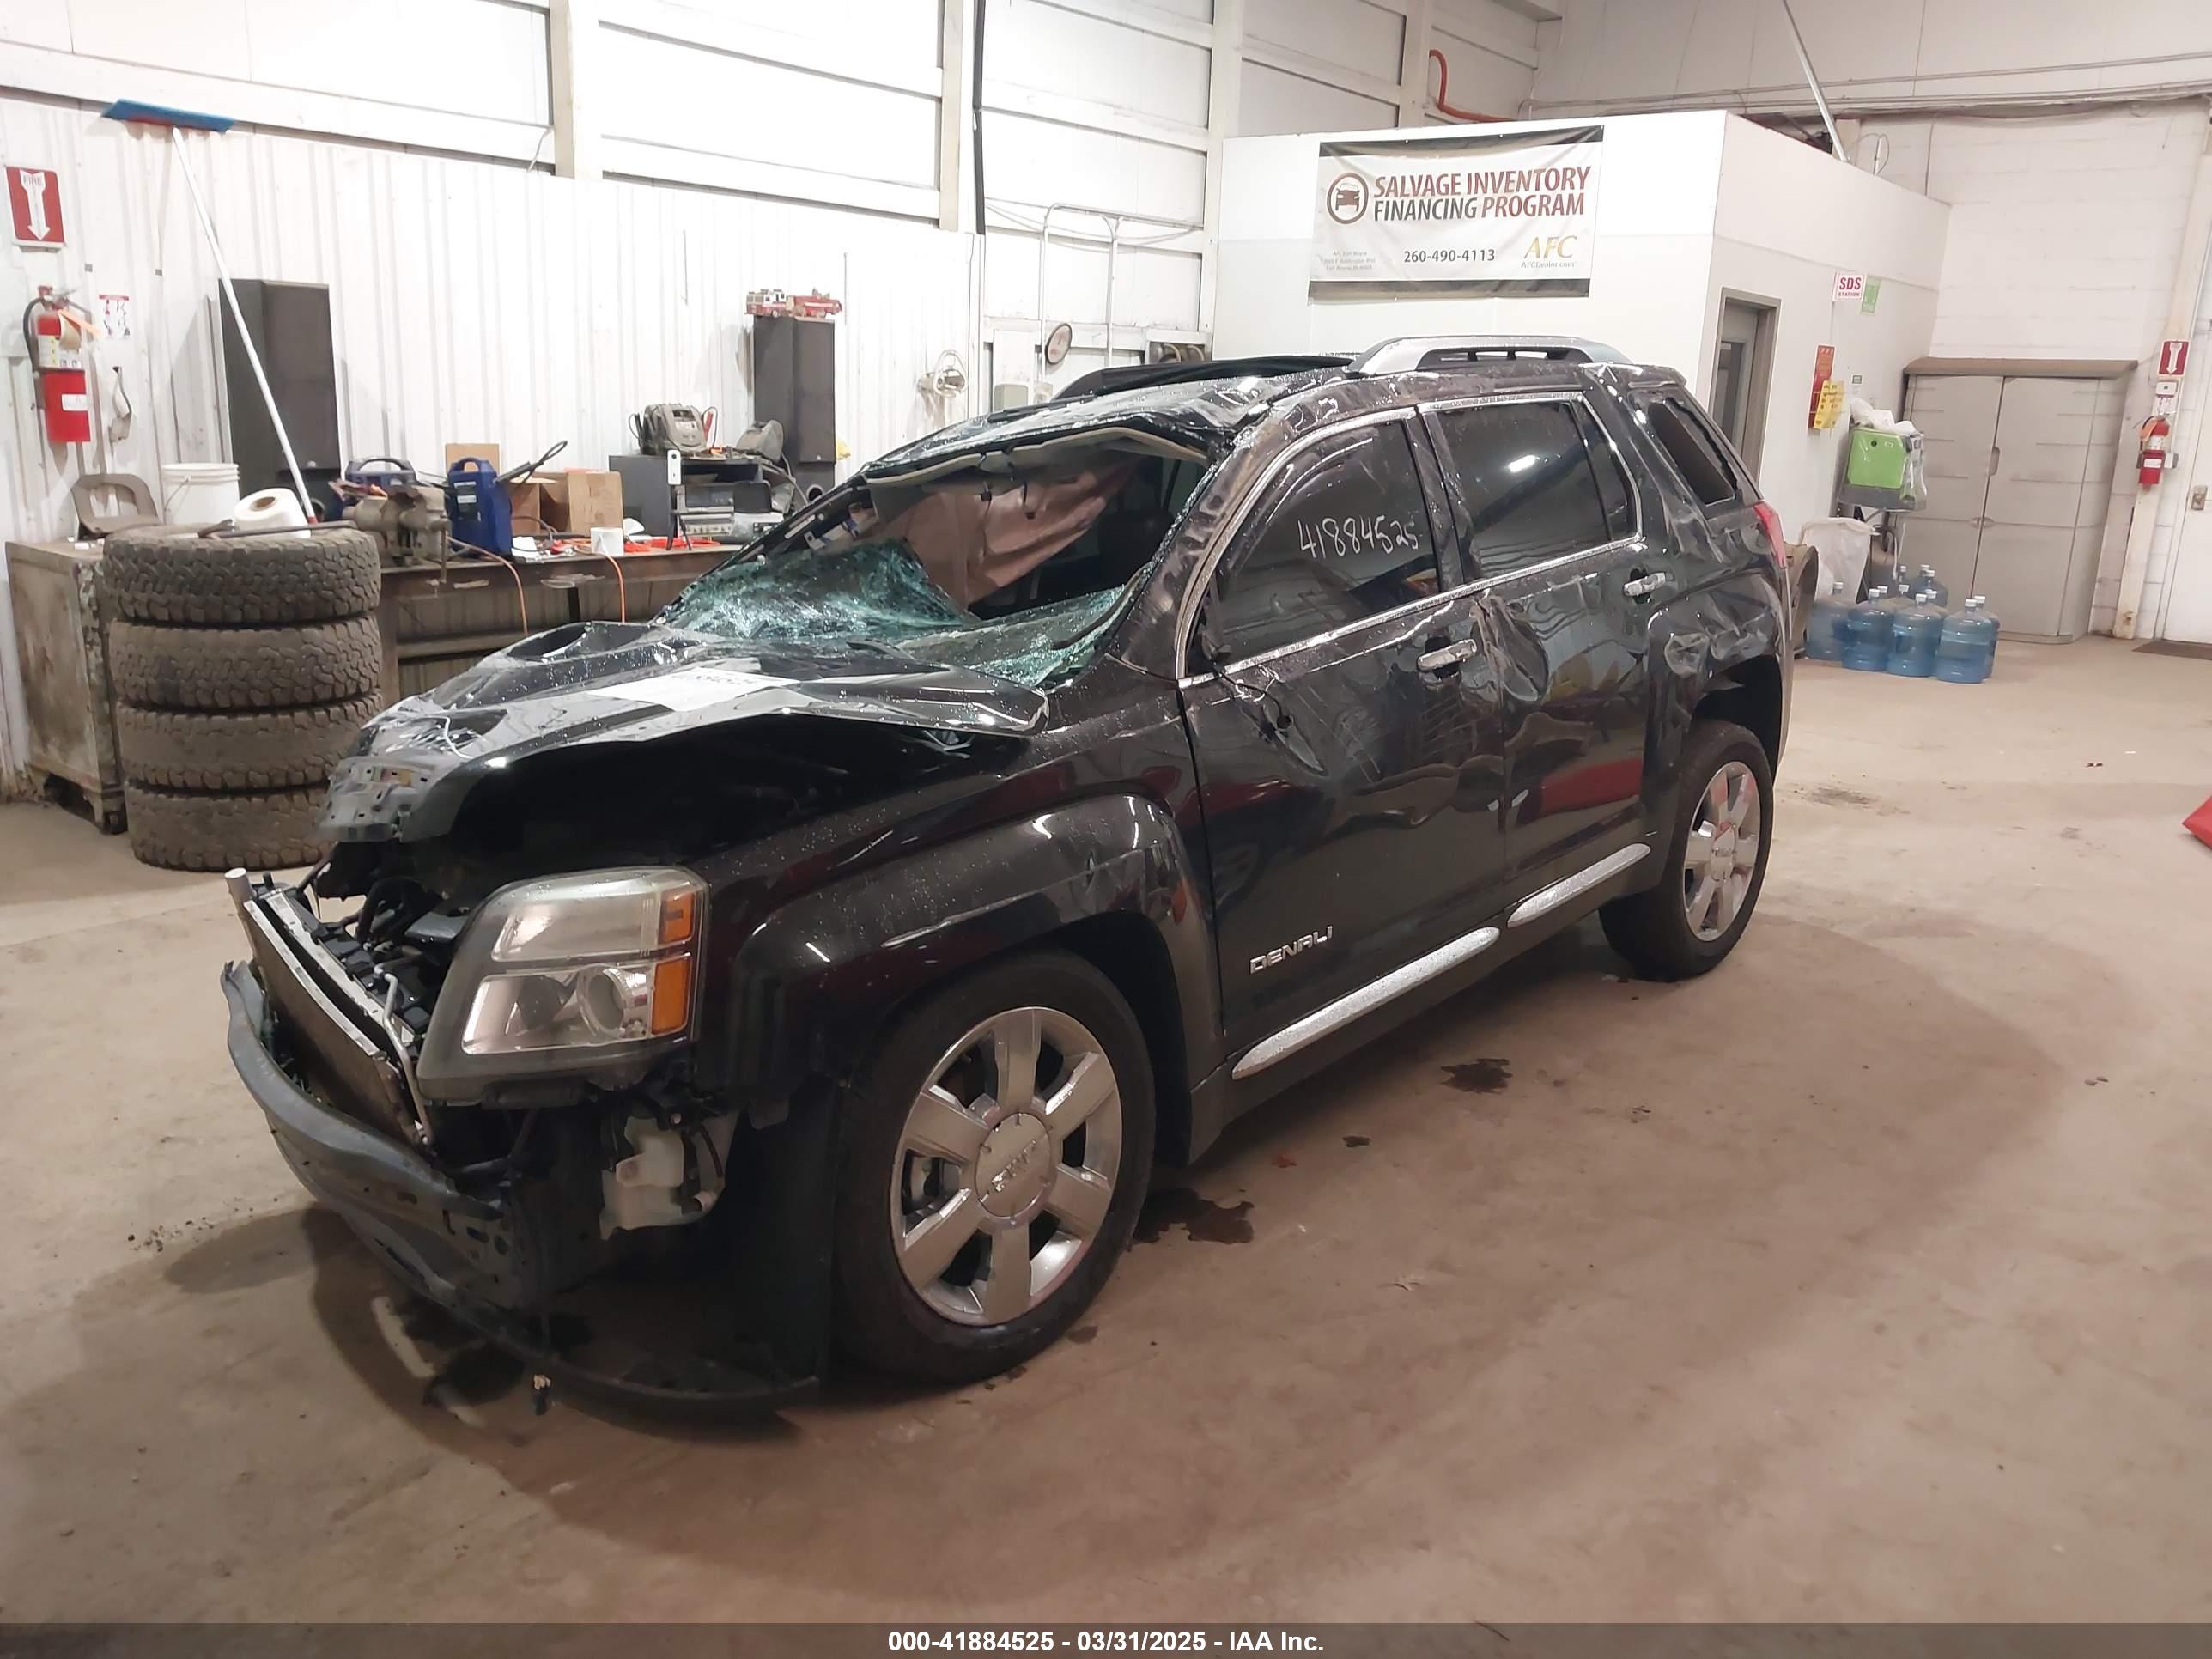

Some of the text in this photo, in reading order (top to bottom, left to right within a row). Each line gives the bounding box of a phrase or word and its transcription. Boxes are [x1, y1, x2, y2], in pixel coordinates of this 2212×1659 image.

[1373, 166, 1591, 198] SALVAGE INVENTORY
[1374, 192, 1585, 222] FINANCING PROGRAM
[1404, 249, 1495, 263] 260-490-4113
[1523, 235, 1577, 259] AFC
[1839, 277, 1862, 290] SDS
[1297, 515, 1419, 558] 41884525
[1249, 926, 1333, 974] DENALI
